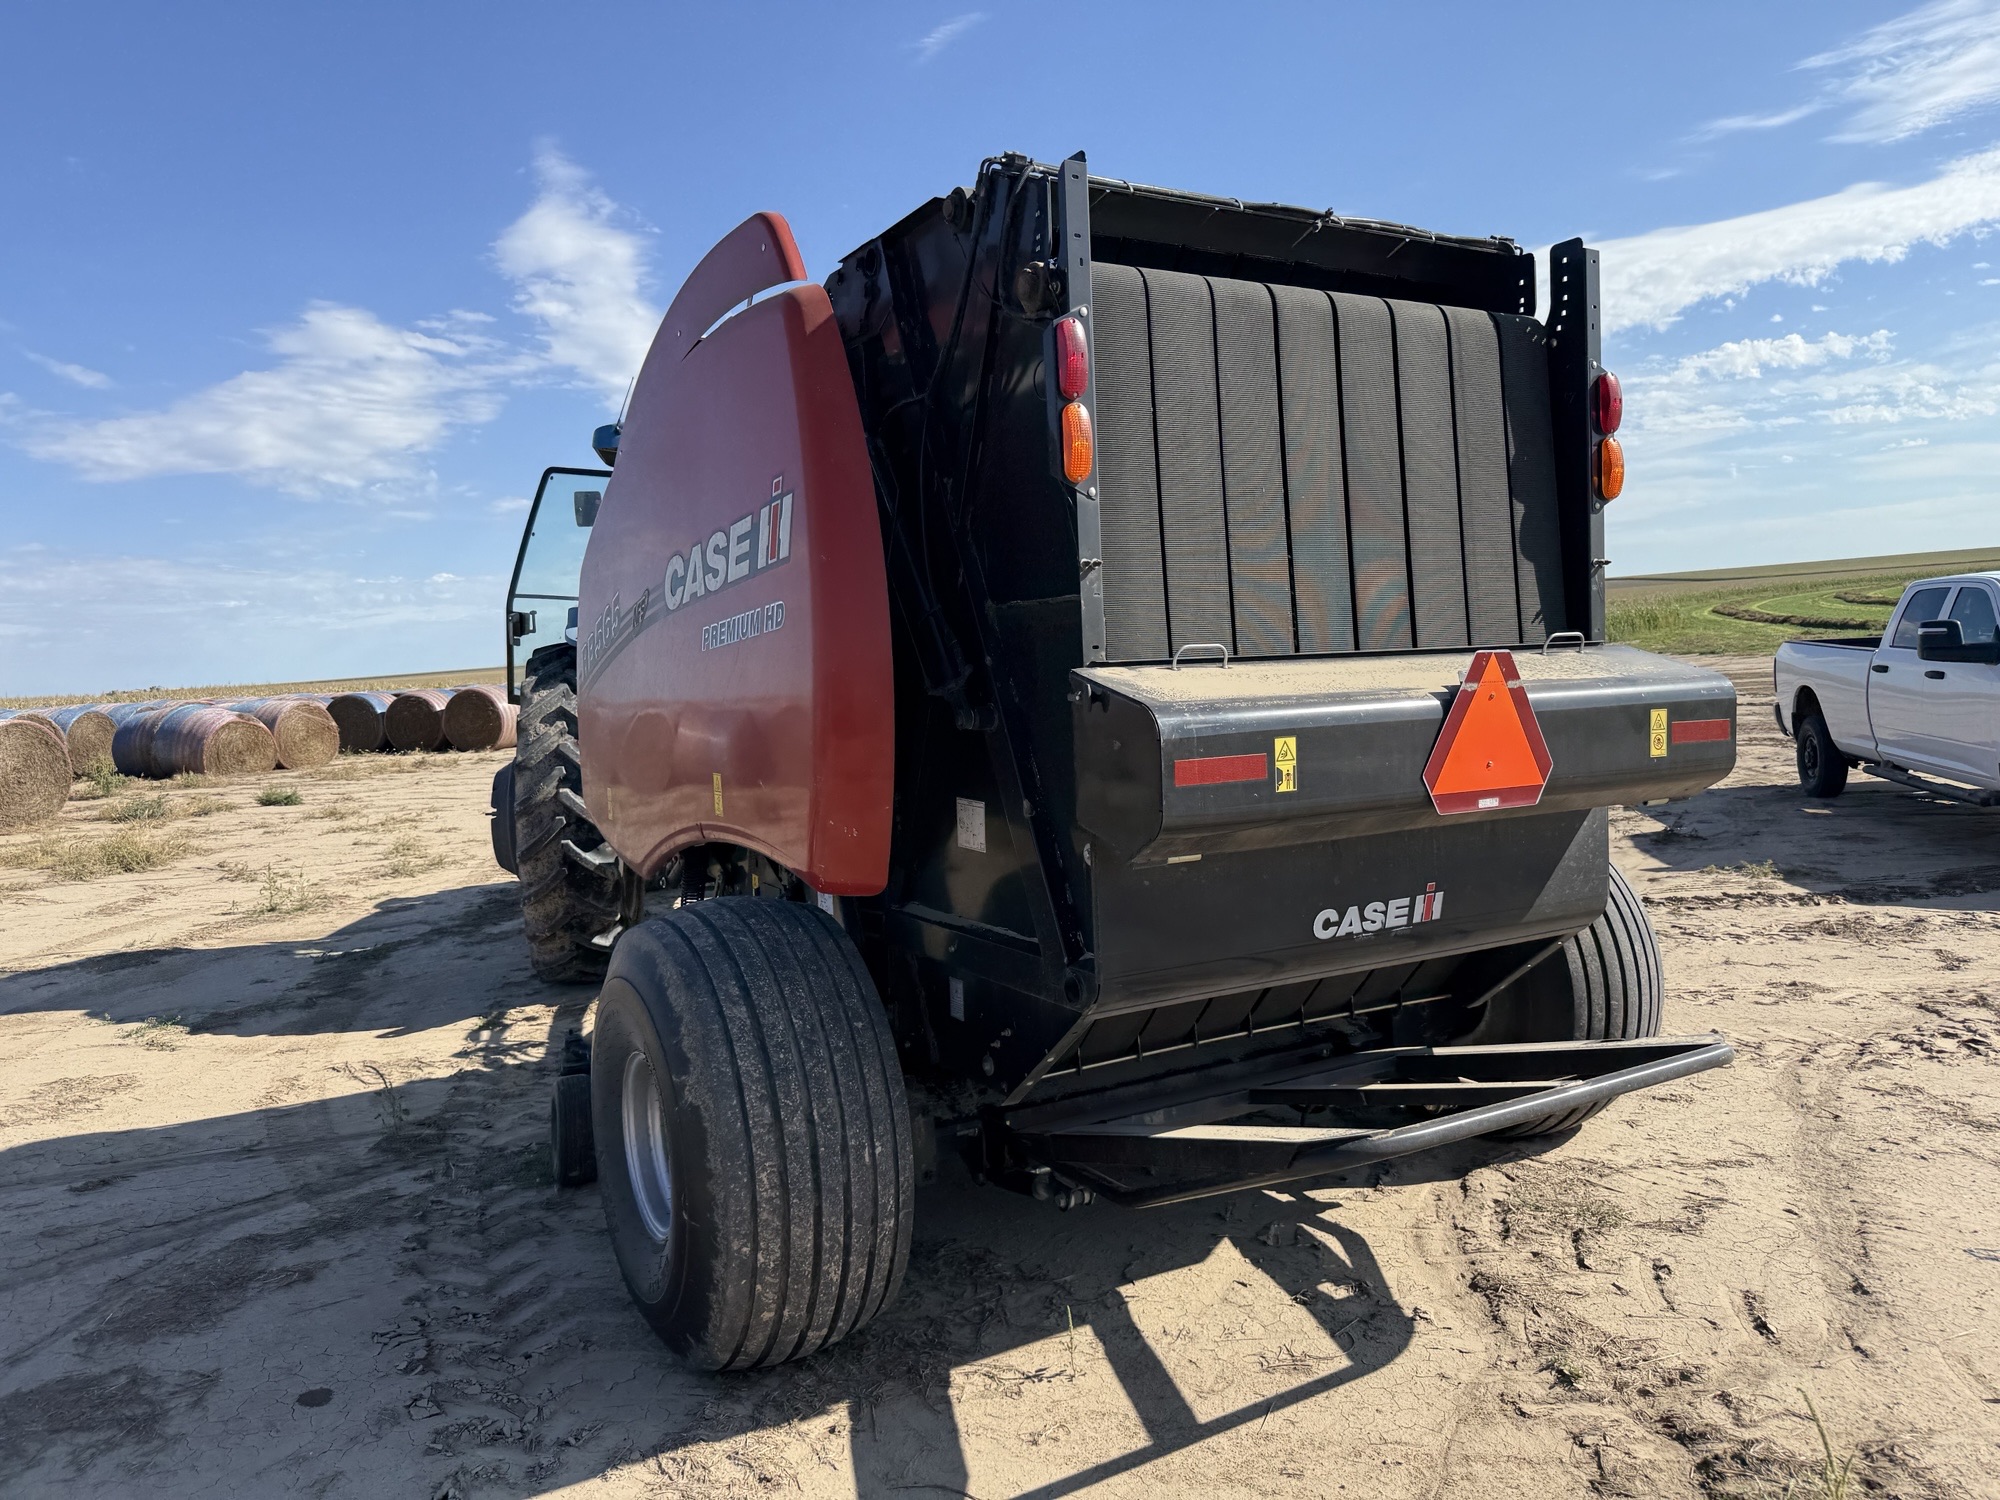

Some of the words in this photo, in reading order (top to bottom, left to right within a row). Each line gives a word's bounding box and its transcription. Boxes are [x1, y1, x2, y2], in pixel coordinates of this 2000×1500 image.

[664, 514, 753, 611] CASE
[701, 607, 761, 652] PREMIUM
[763, 600, 785, 633] HD
[1313, 897, 1410, 940] CASE
